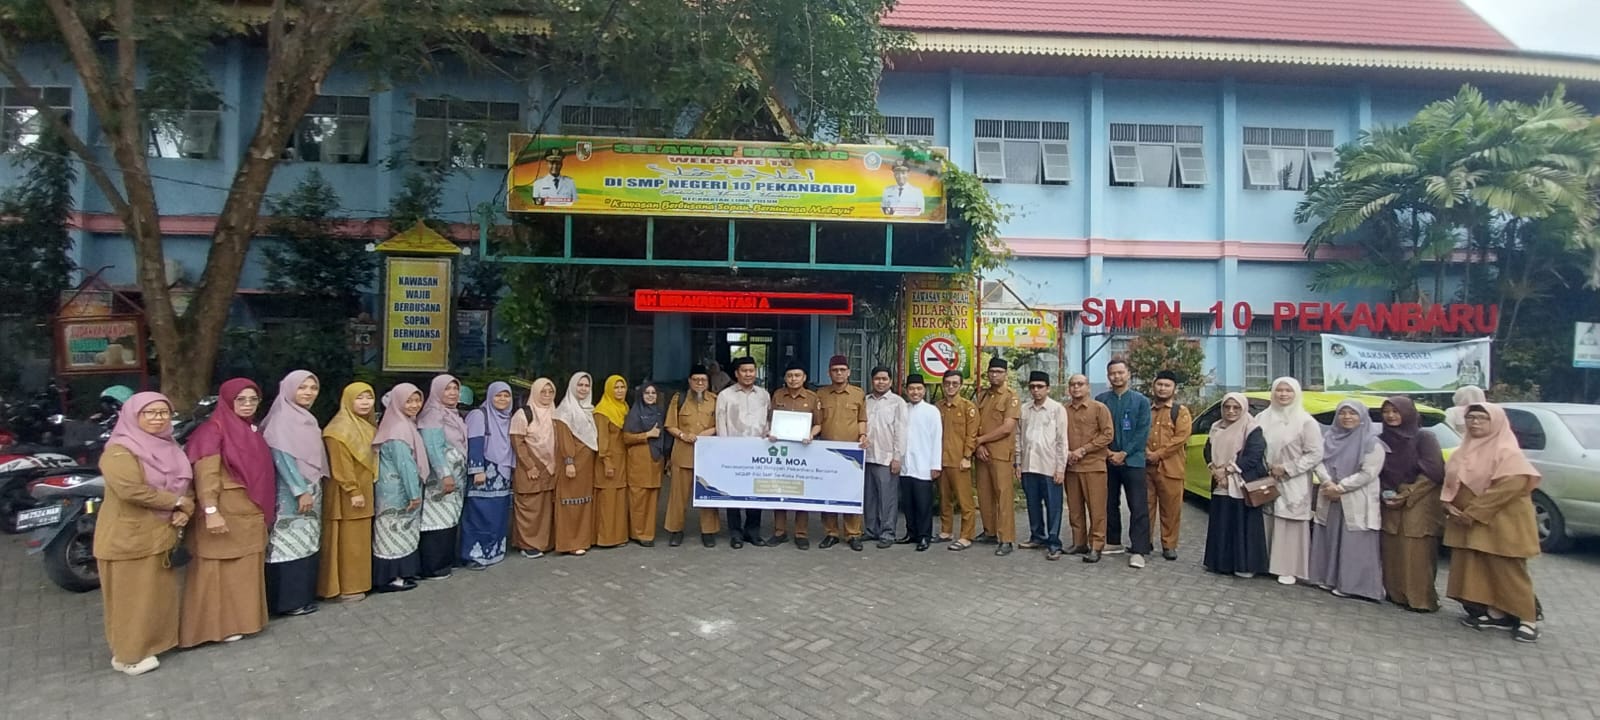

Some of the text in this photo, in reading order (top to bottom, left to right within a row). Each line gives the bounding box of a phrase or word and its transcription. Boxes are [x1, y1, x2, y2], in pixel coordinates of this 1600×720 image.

[613, 143, 849, 160] SELAMAT DATANG
[669, 157, 765, 166] WELCOME
[604, 177, 623, 187] DI
[627, 178, 665, 188] SMP
[668, 180, 728, 190] NEGERI
[733, 181, 751, 190] 10
[755, 182, 856, 194] PEKANBARU
[661, 201, 715, 211] Berbusana
[753, 203, 807, 213] Bernuansa
[398, 276, 438, 287] KAWASAN
[405, 290, 431, 300] WAJIB
[393, 303, 441, 313] BERBUSANA
[758, 297, 771, 309] A
[911, 304, 968, 316] DILARANG
[1081, 297, 1499, 334] SMPN 10 PEKANBARU
[403, 316, 431, 326] SOPAN
[911, 317, 968, 329] MEROKOK
[393, 329, 441, 339] BERNUANSA
[401, 342, 433, 352] MELAYU
[1358, 351, 1433, 360] MAKAN BERGIZI
[1344, 361, 1368, 370] HAK
[1369, 361, 1395, 370] ANAK
[751, 456, 807, 466] MOU & MOA
